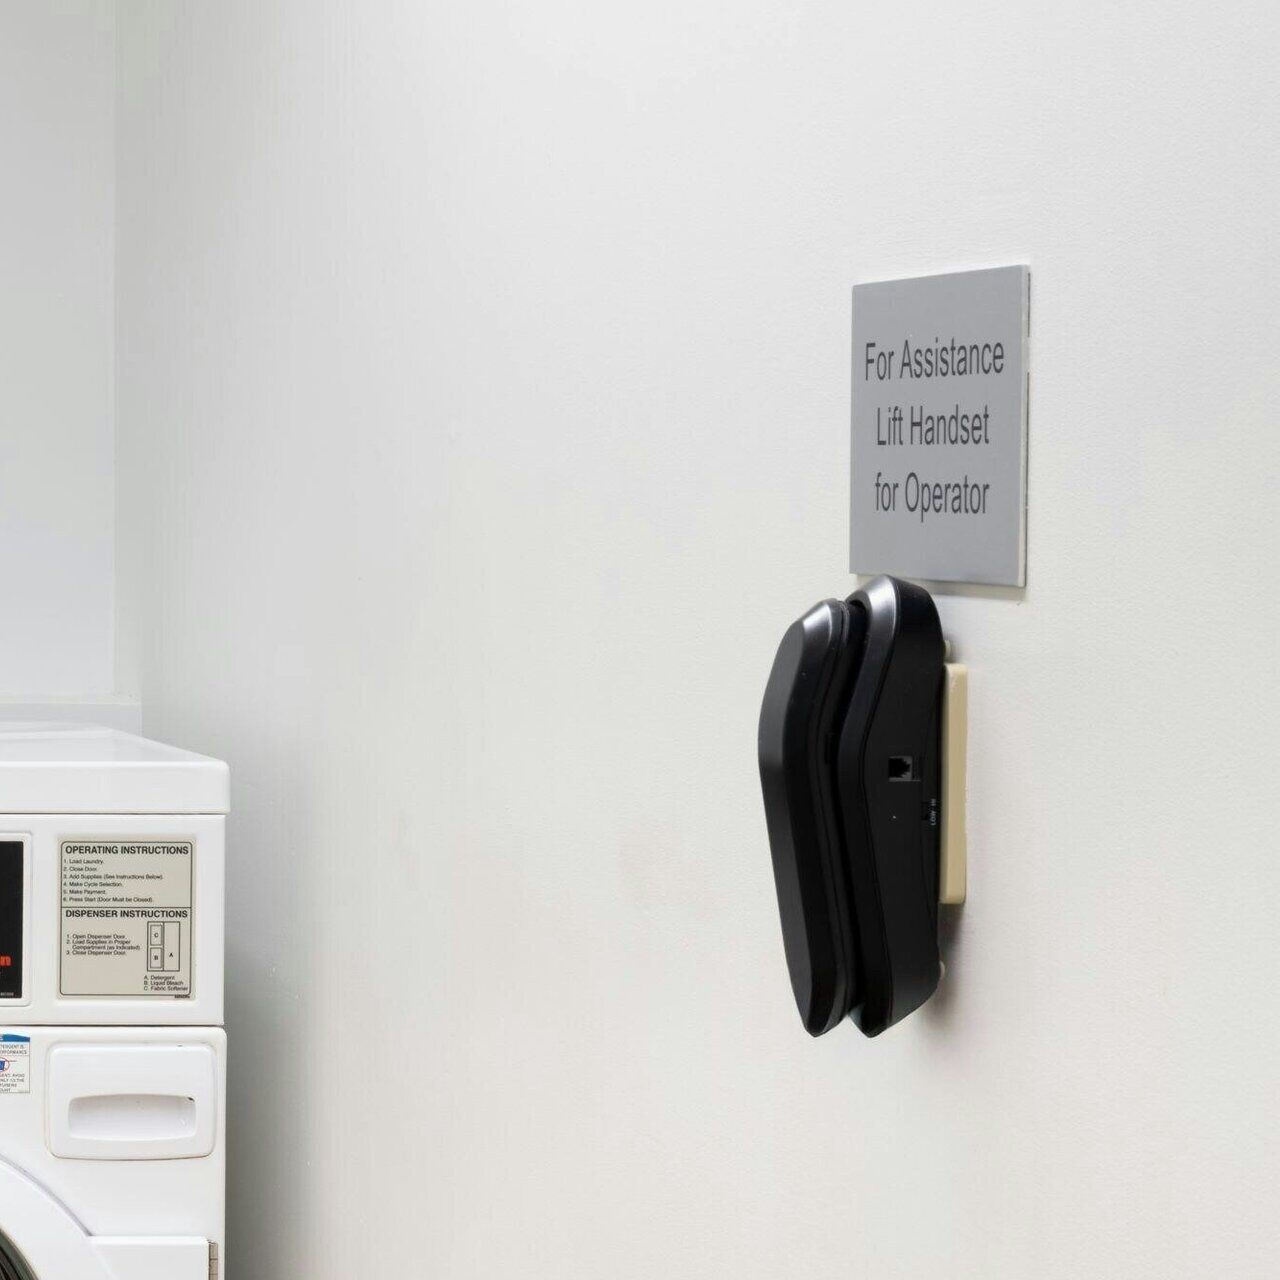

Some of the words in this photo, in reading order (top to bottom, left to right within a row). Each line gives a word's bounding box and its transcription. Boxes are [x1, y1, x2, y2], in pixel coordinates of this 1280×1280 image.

[866, 342, 894, 381] For
[900, 337, 1004, 379] Assistance
[877, 406, 903, 445] Lift
[910, 404, 990, 445] Handset
[876, 472, 899, 511] for
[905, 472, 990, 523] Operator
[65, 846, 118, 854] OPERATING
[121, 846, 189, 854] INSTRUCTIONS
[66, 910, 118, 918] DISPENSER
[120, 910, 188, 918] INSTRUCTIONS
